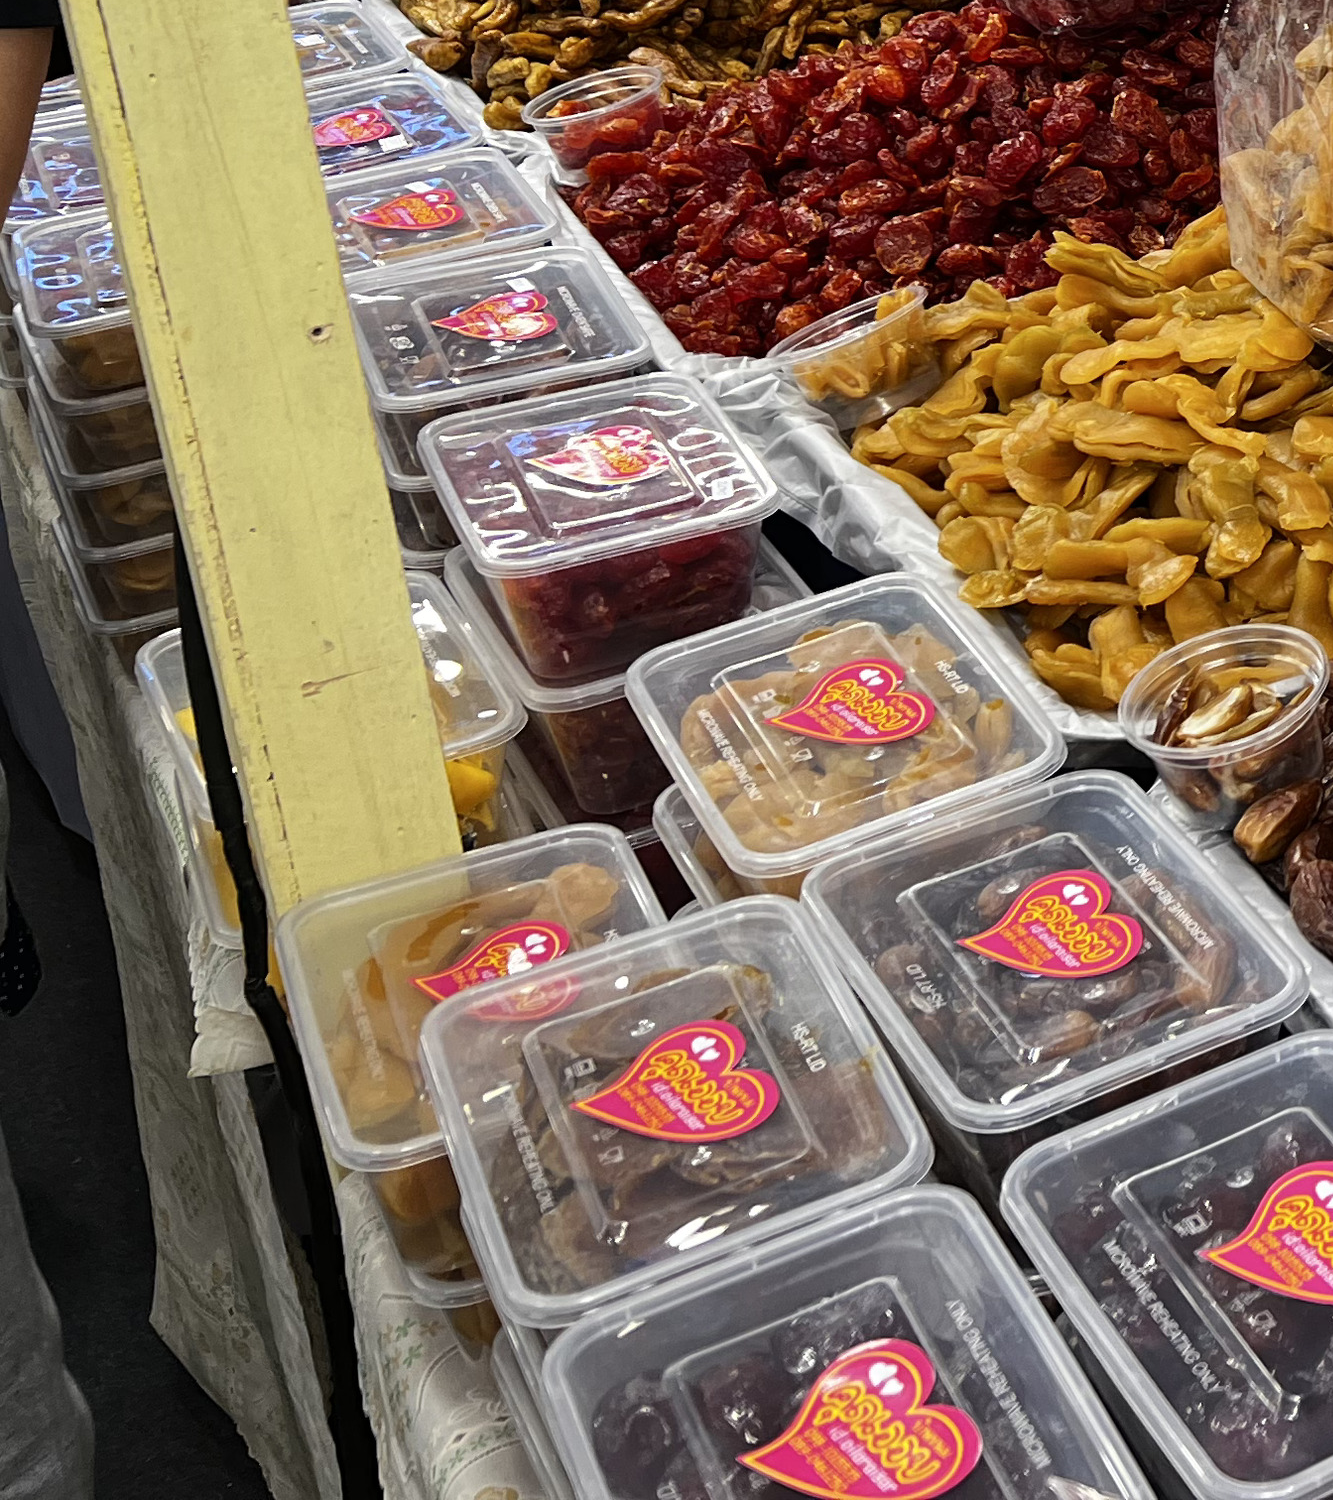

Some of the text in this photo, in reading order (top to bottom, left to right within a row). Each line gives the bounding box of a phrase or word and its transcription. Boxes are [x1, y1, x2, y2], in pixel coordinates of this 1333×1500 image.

[1116, 842, 1214, 948] MICROWAVE REHEATING ONLY
[943, 1296, 1054, 1467] MICROWAVE REHEATING ONLY
